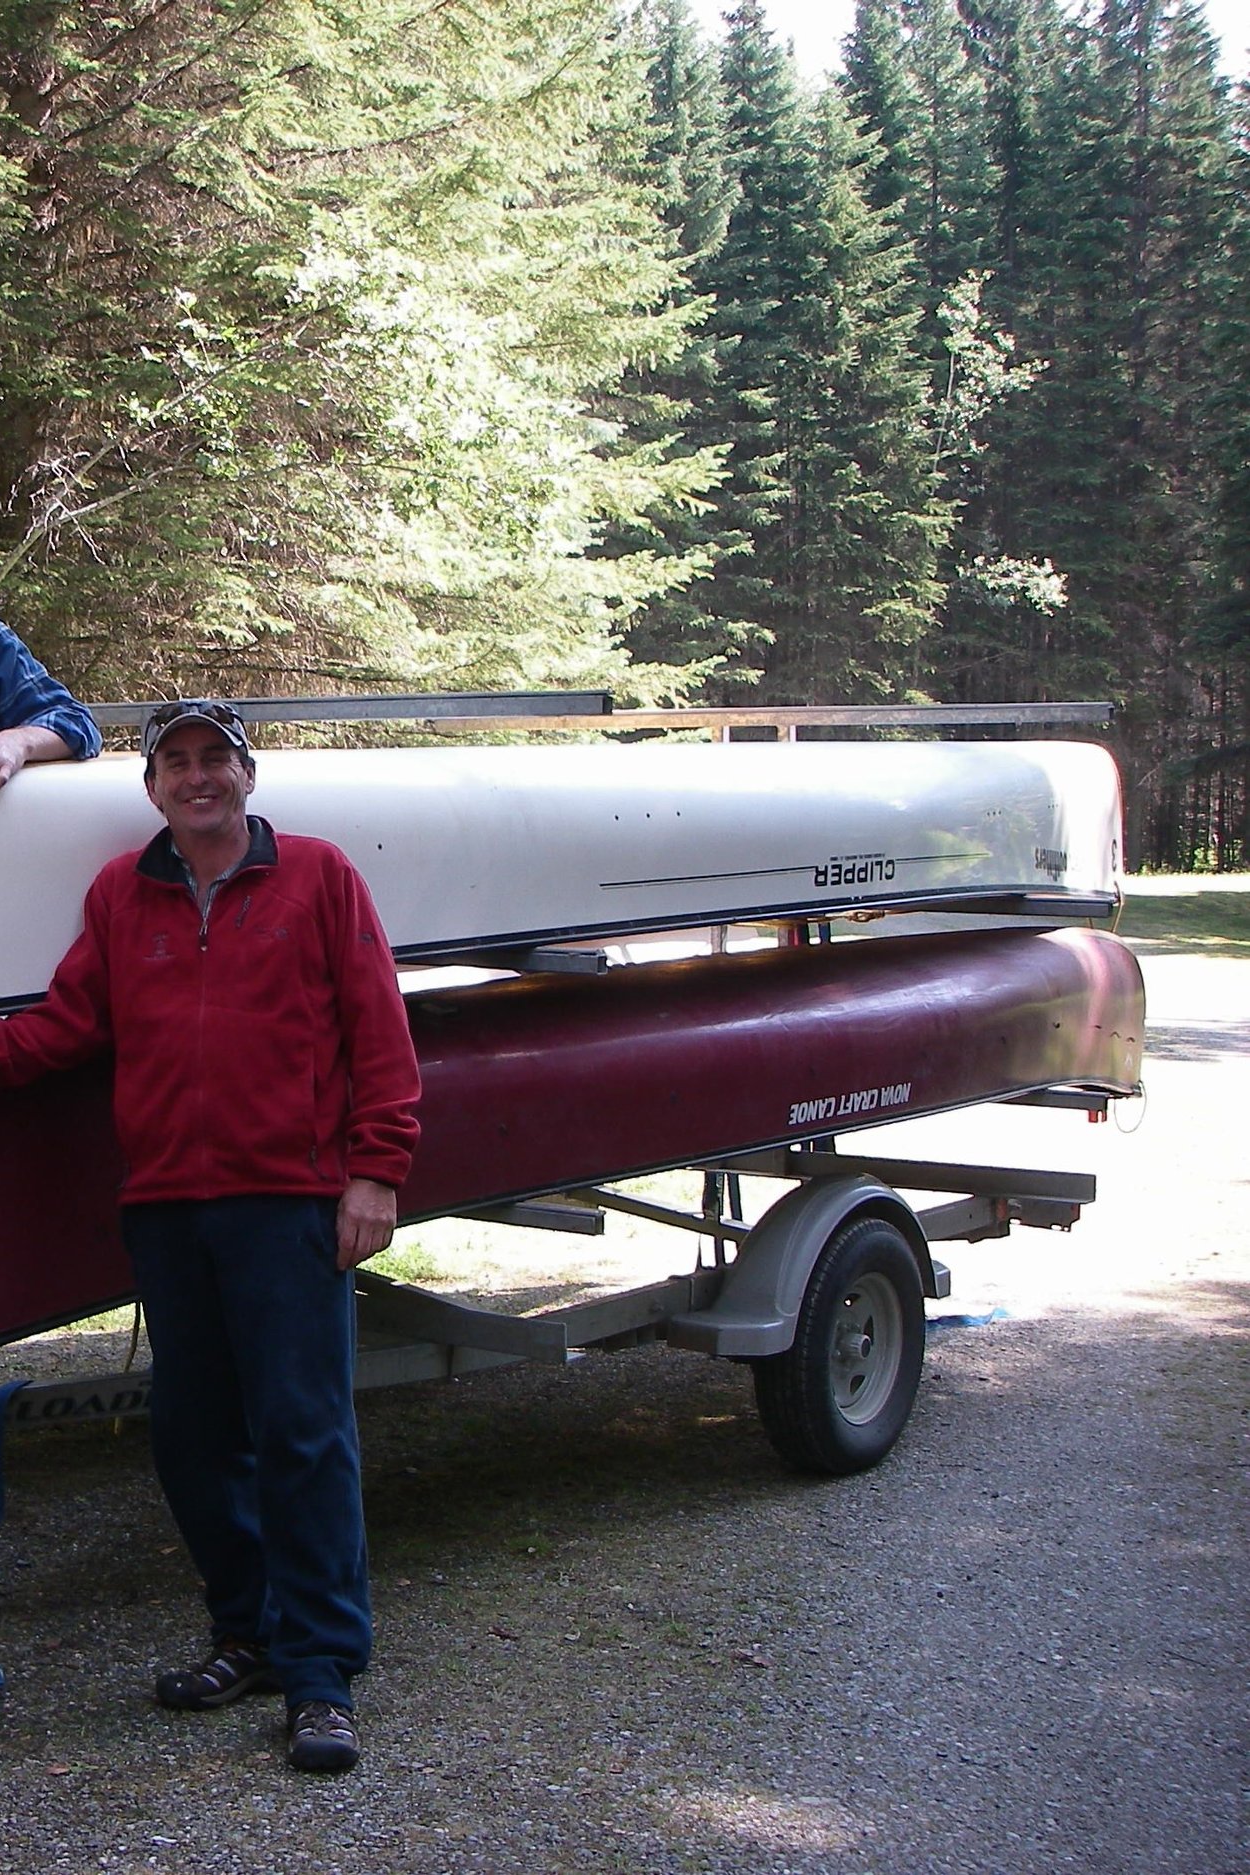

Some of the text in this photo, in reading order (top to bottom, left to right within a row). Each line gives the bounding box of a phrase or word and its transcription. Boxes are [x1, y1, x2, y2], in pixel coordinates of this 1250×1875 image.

[814, 859, 896, 887] CLIPPER
[788, 1082, 912, 1125] NOVA CRAFT CANOE
[16, 1390, 152, 1424] LOAD
